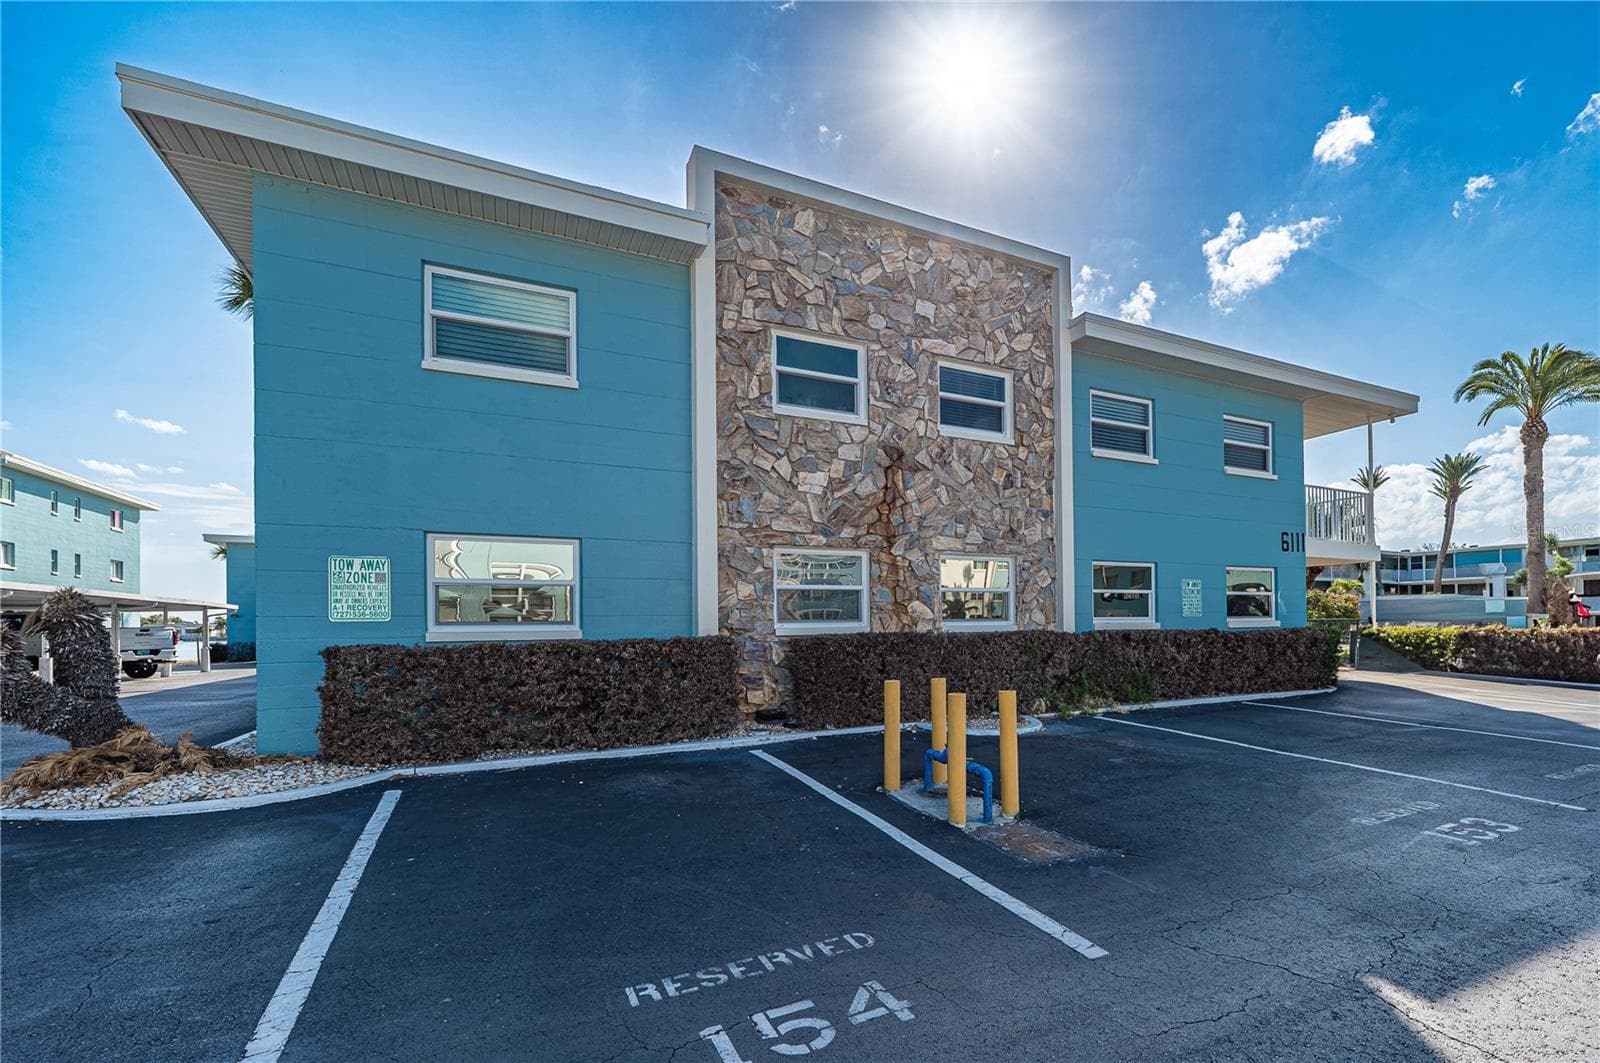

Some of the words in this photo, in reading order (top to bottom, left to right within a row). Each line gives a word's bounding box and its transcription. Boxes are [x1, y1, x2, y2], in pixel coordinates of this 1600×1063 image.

[1281, 532, 1305, 552] 6111
[333, 559, 354, 571] TOW
[360, 559, 386, 571] AWAY
[346, 572, 375, 583] ZONE
[624, 932, 876, 1008] RESERVED
[699, 980, 916, 1063] 154
